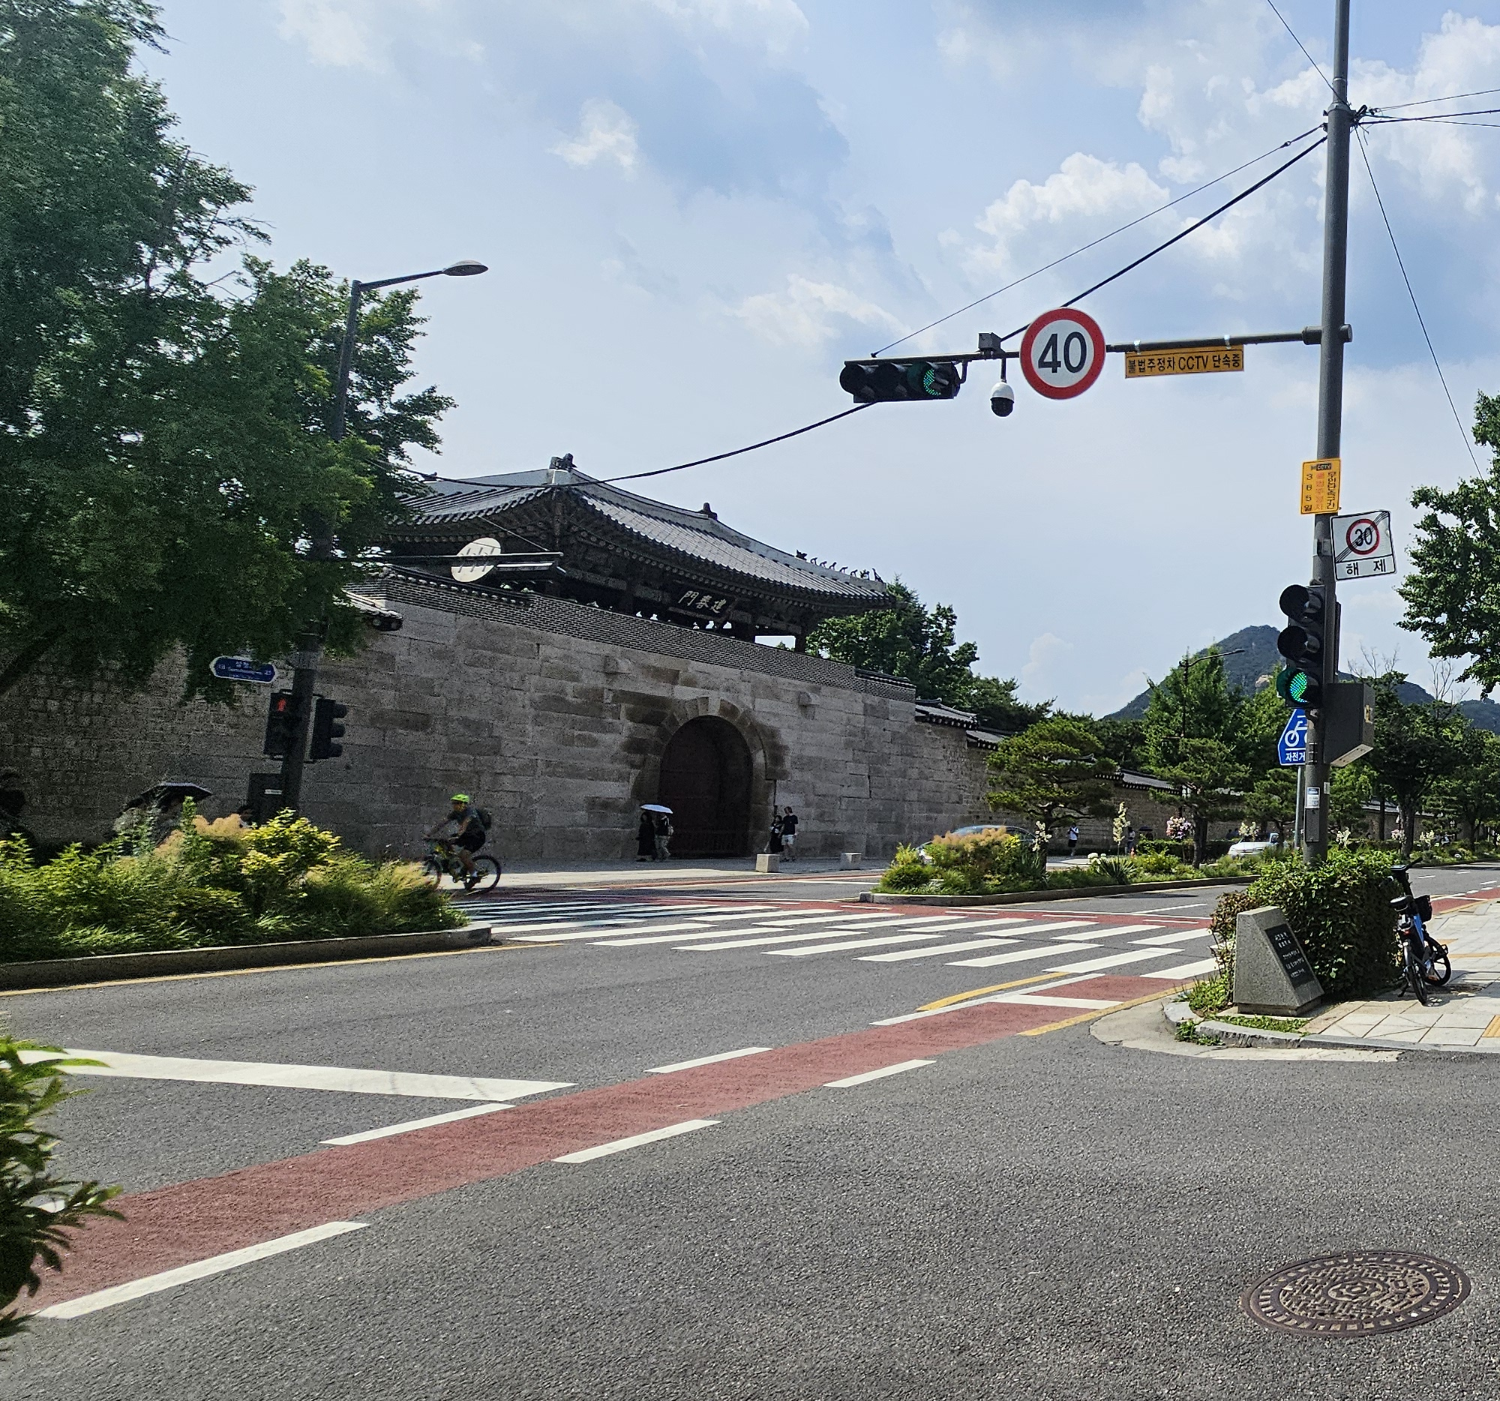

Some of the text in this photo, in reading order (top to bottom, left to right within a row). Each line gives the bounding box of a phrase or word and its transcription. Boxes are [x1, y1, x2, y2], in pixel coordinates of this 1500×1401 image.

[1038, 331, 1087, 374] 40
[1127, 352, 1242, 375] 불법주정차 CCTV 단속중
[1354, 527, 1373, 547] 30
[1285, 751, 1306, 762] 자전거
